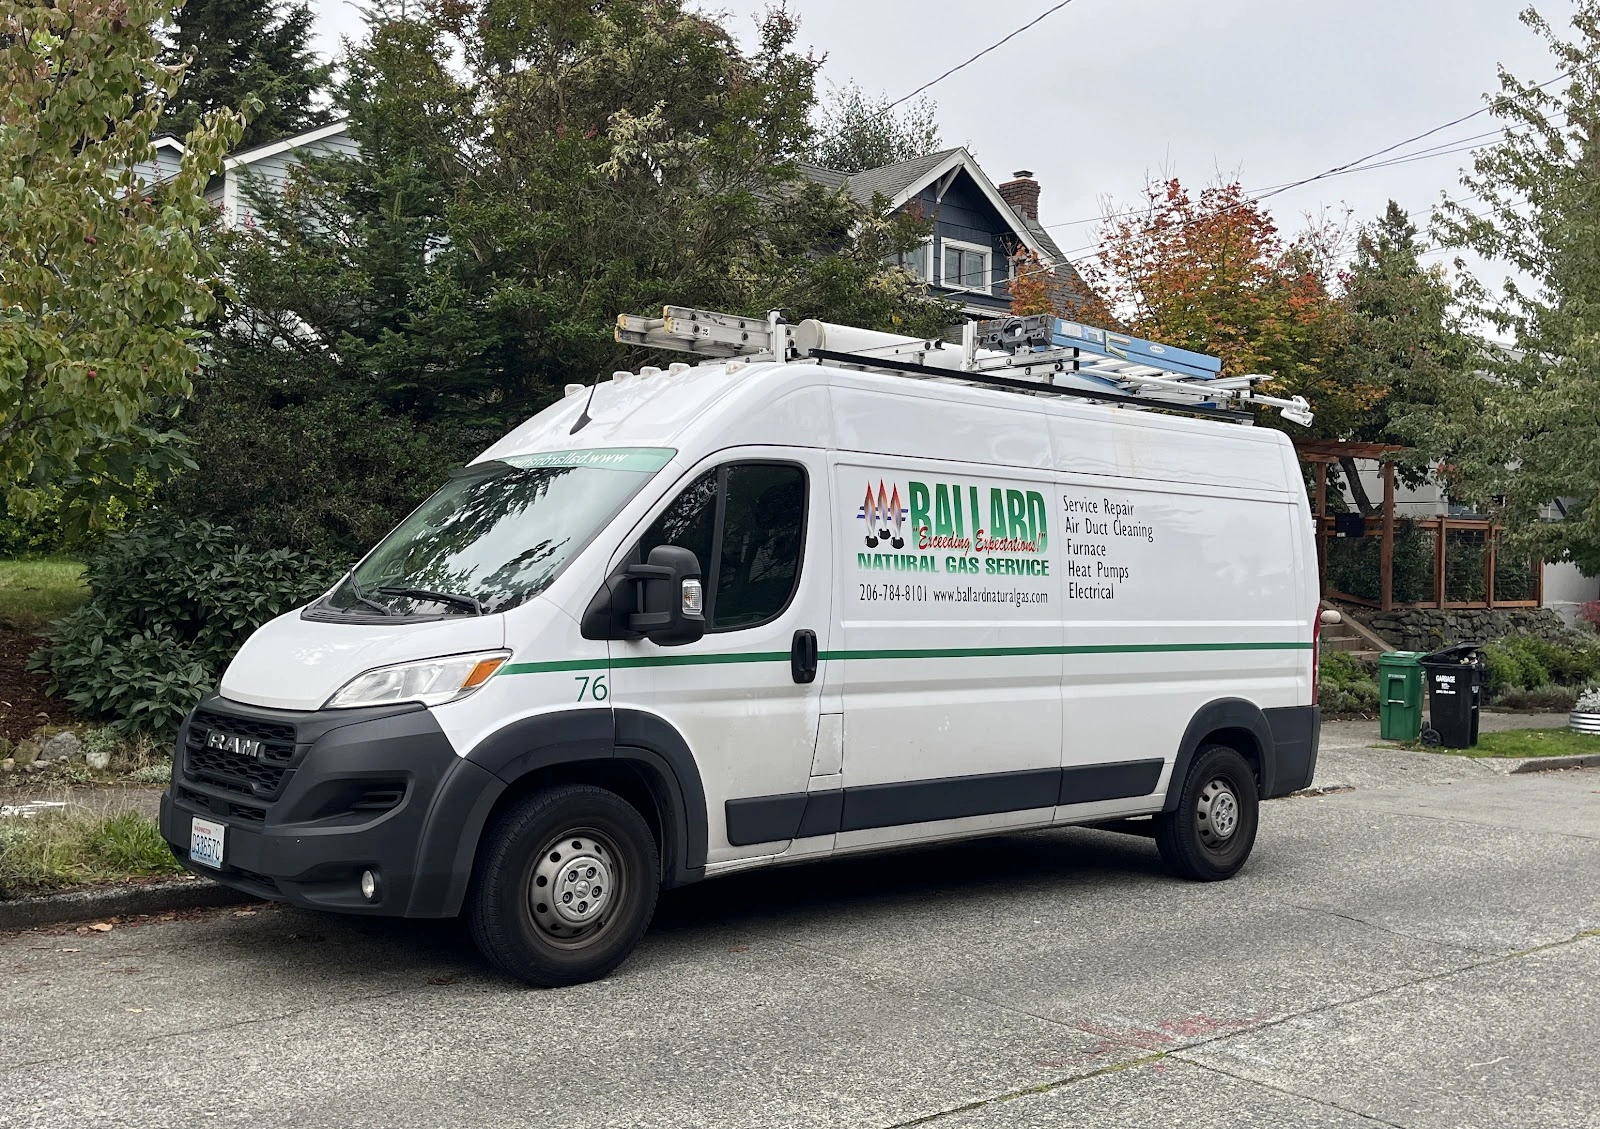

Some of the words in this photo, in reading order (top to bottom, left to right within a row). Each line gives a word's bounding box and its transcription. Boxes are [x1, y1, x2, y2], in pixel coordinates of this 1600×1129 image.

[908, 481, 1048, 555] BALLARD
[1063, 495, 1098, 513] Service
[1104, 498, 1134, 520] Repair
[1066, 516, 1080, 534] Air
[1086, 518, 1108, 536] Duct
[1114, 519, 1154, 542] Cleaning
[1067, 538, 1106, 556] Furnace
[857, 553, 940, 574] NATURAL
[946, 556, 980, 574] GAS
[986, 558, 1050, 576] SERVICE
[1068, 560, 1092, 578] Heat
[1098, 561, 1128, 584] Pumps
[860, 584, 927, 602] 206-784-8101
[933, 586, 1048, 608] www.ballardnaturalgas.com
[1069, 582, 1114, 600] Electrical
[575, 675, 607, 702] 76
[1436, 674, 1456, 684] GARBAGE
[206, 733, 260, 757] RAM
